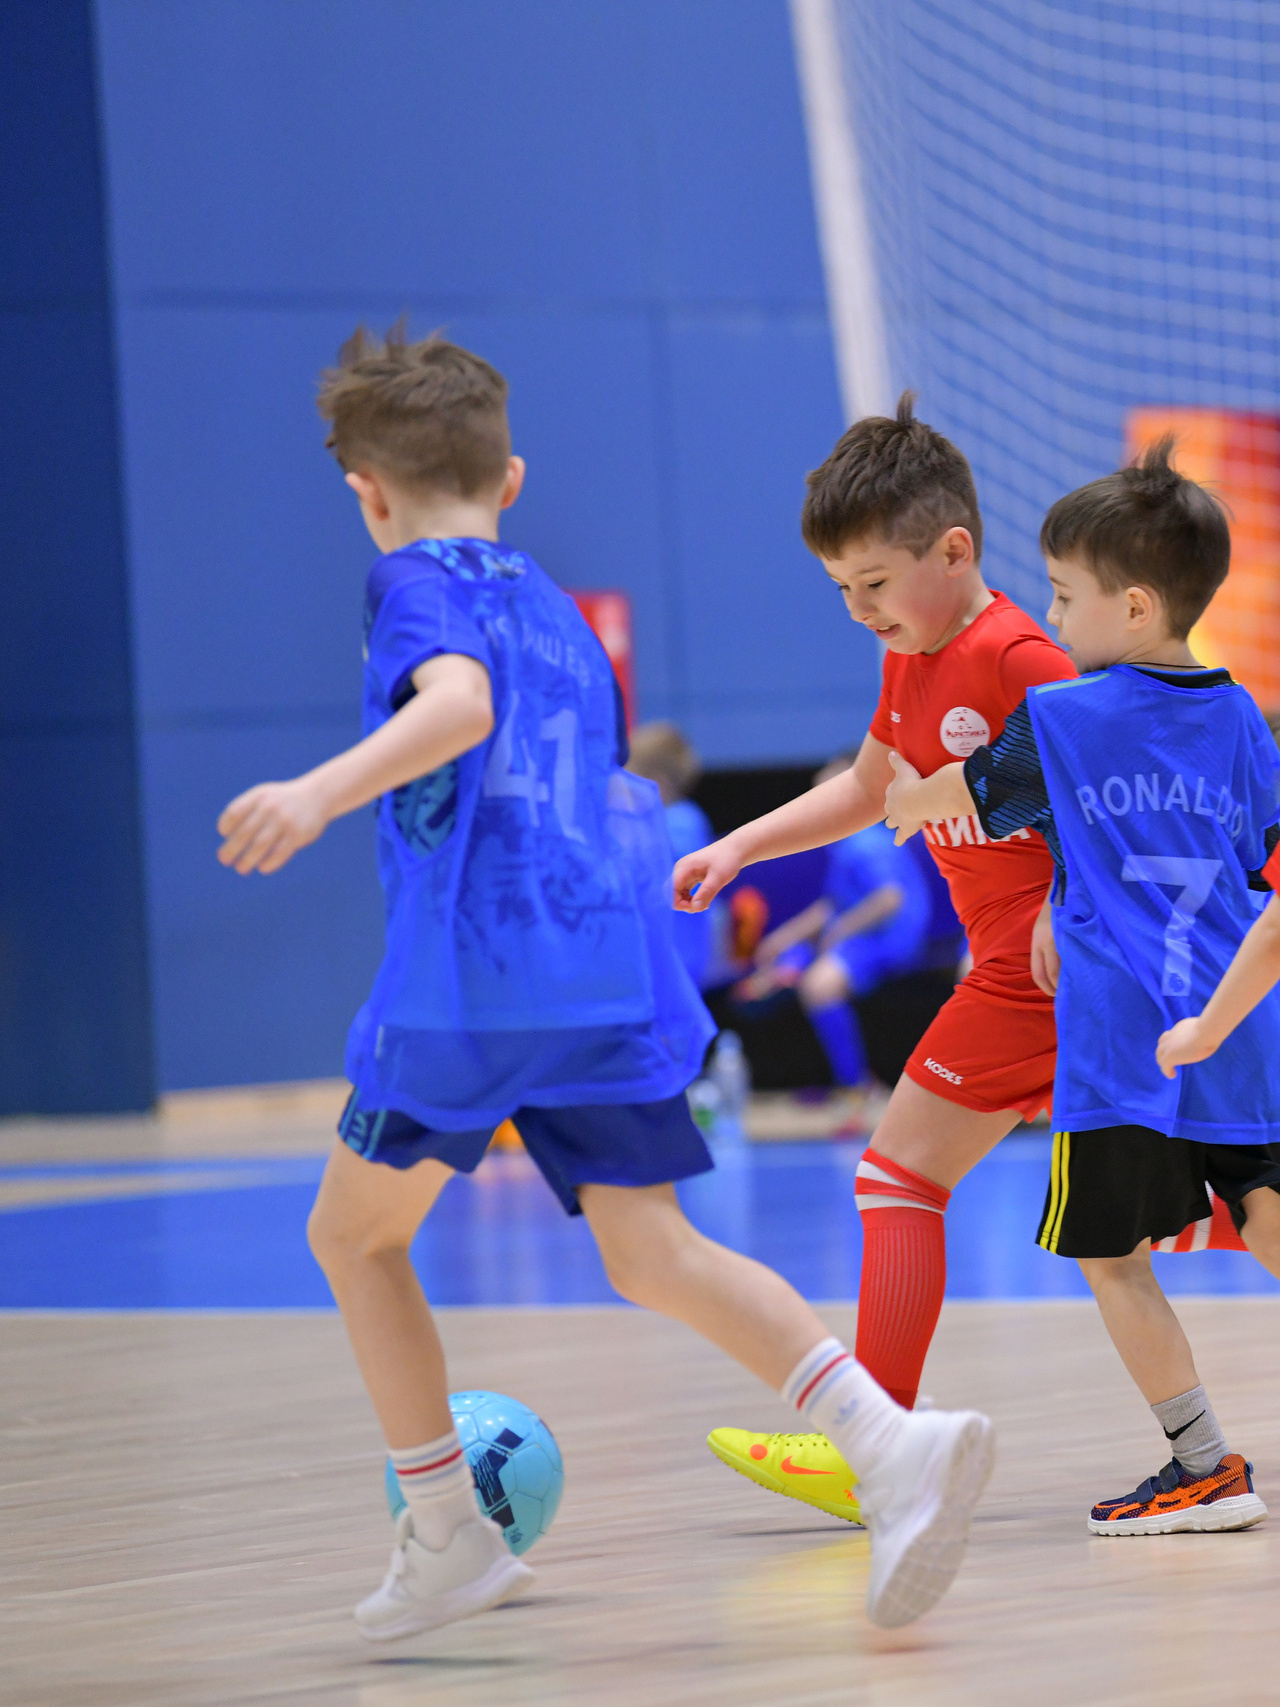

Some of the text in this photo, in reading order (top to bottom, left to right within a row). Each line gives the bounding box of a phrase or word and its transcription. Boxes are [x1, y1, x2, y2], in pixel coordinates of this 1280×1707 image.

[483, 689, 588, 844] 41
[1075, 772, 1244, 839] RONALDO
[1120, 854, 1225, 997] 7
